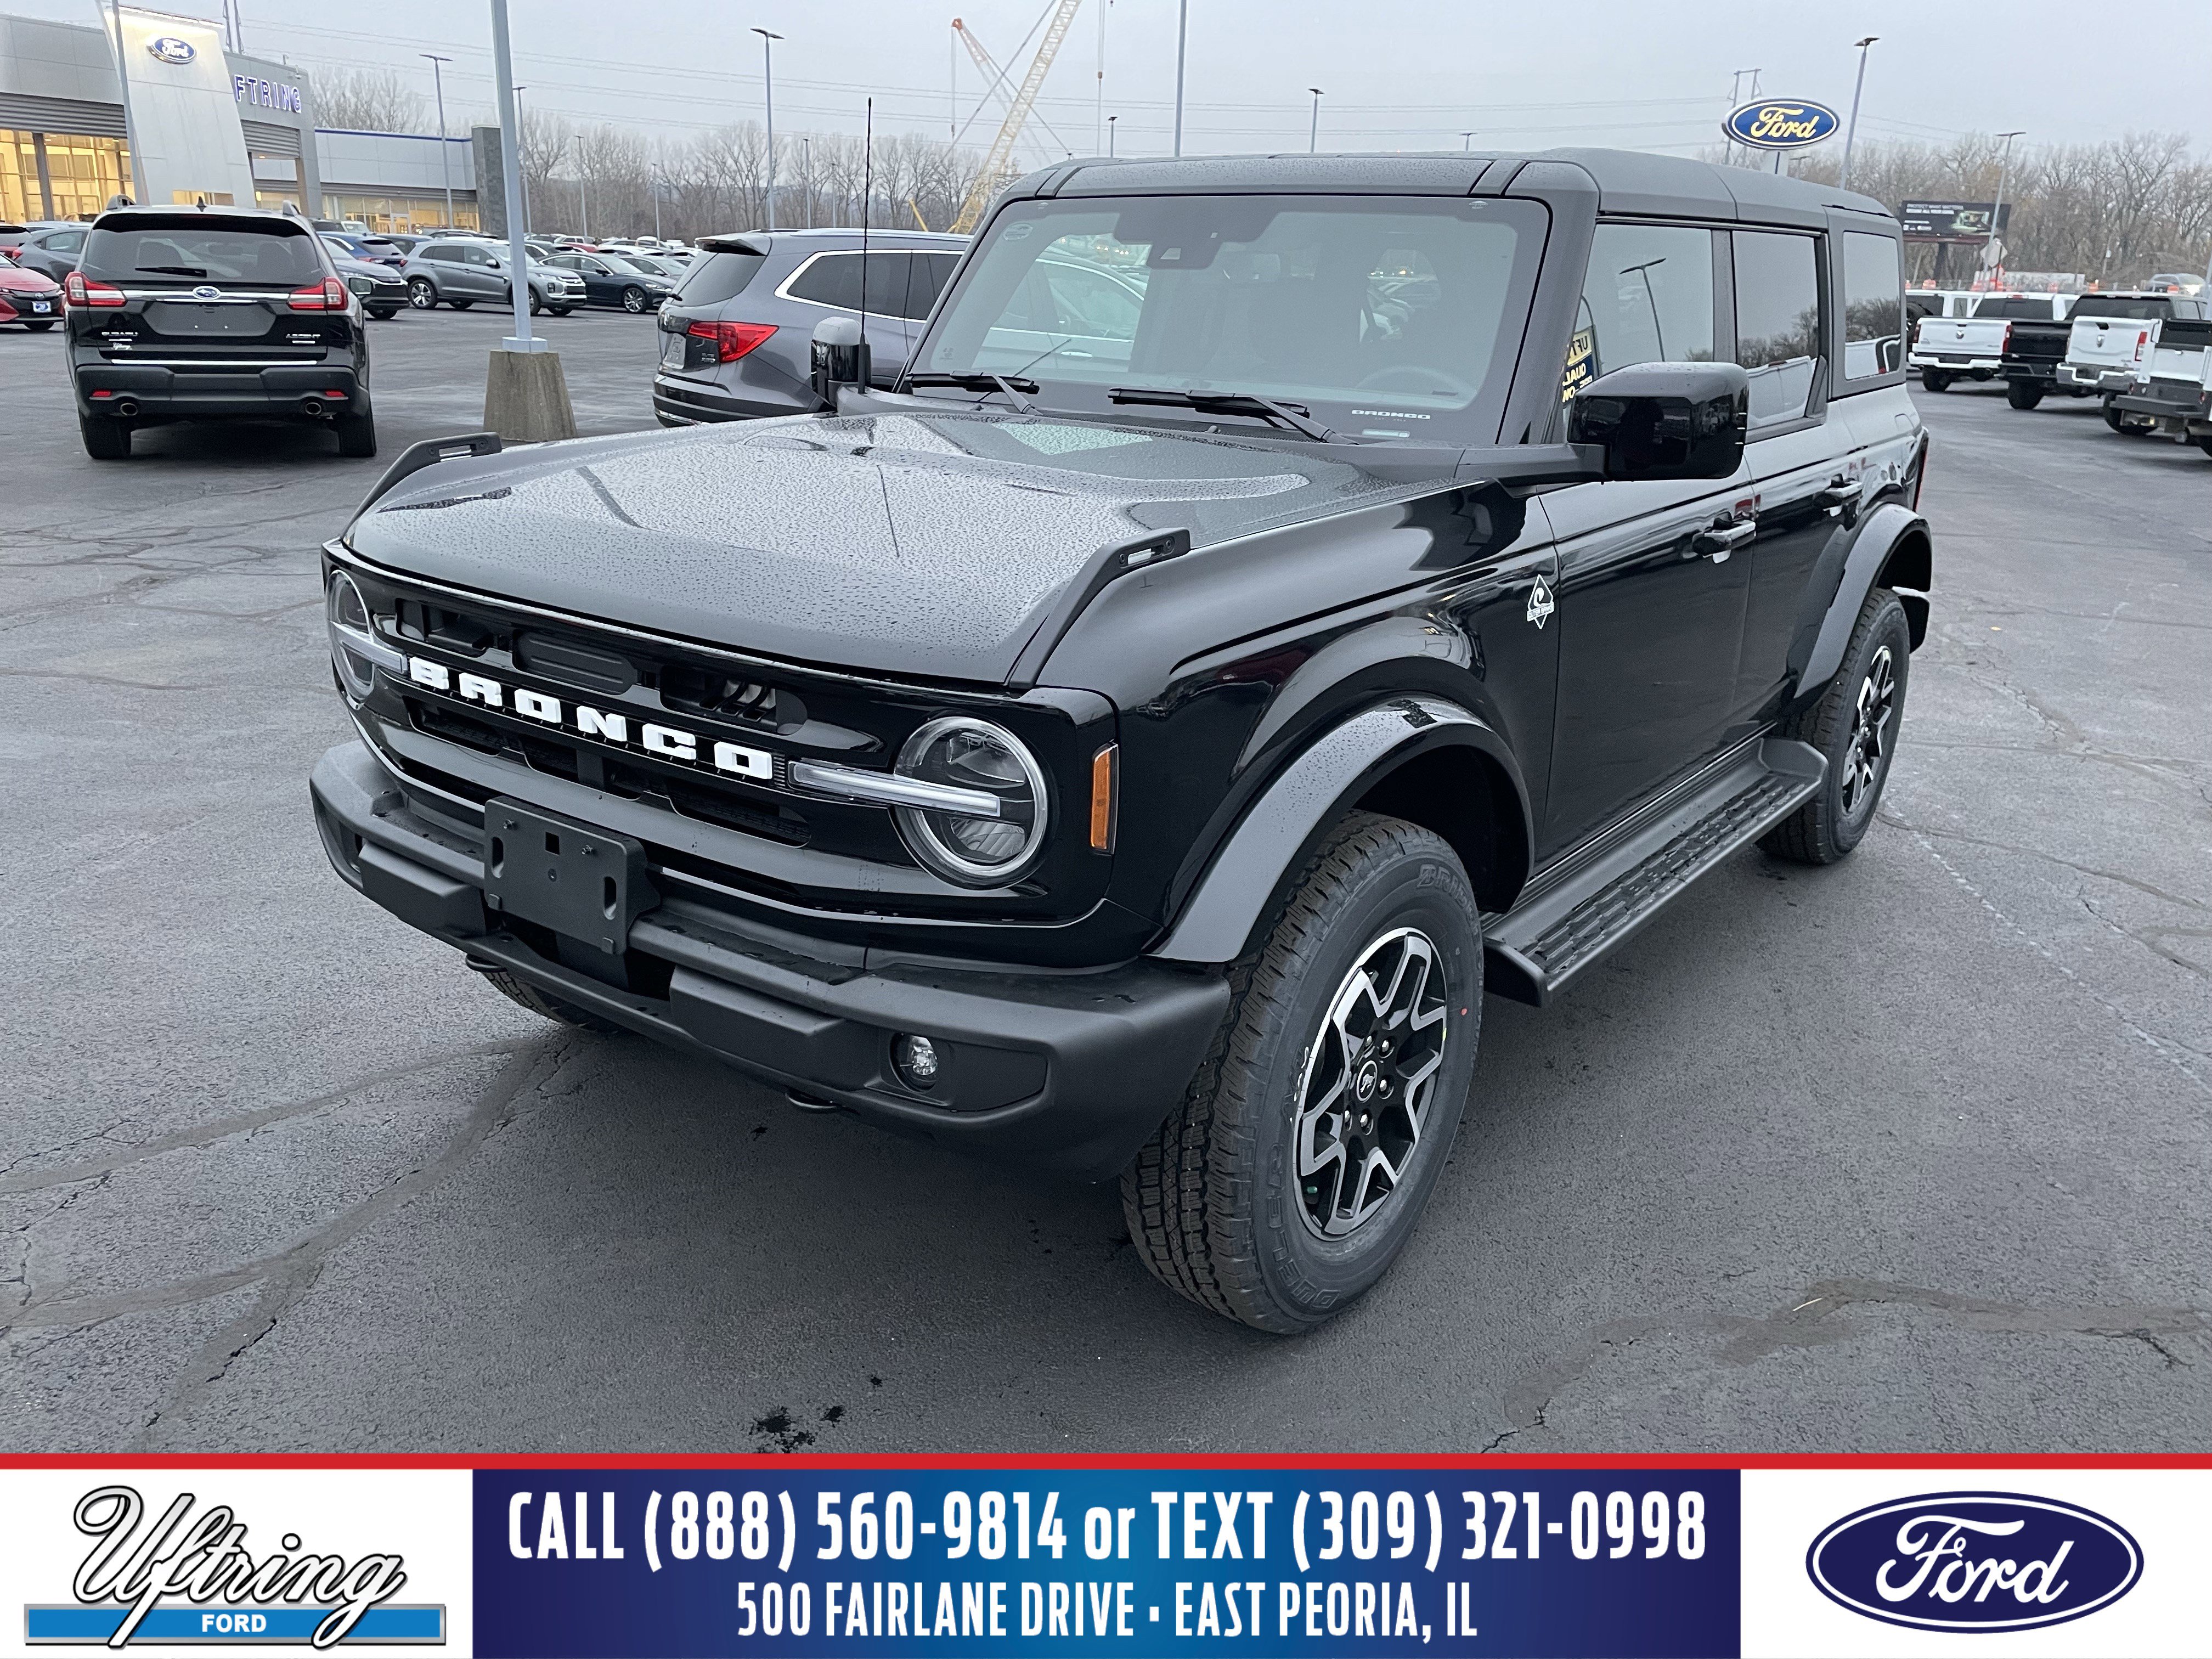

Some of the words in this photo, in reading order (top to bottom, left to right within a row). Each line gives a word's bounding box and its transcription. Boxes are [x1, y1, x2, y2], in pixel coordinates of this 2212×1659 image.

[161, 38, 189, 58] Ford
[234, 75, 301, 113] FTRING
[1750, 106, 1820, 138] Ford
[1352, 409, 1431, 420] BRONCO
[410, 656, 773, 780] BRONCO
